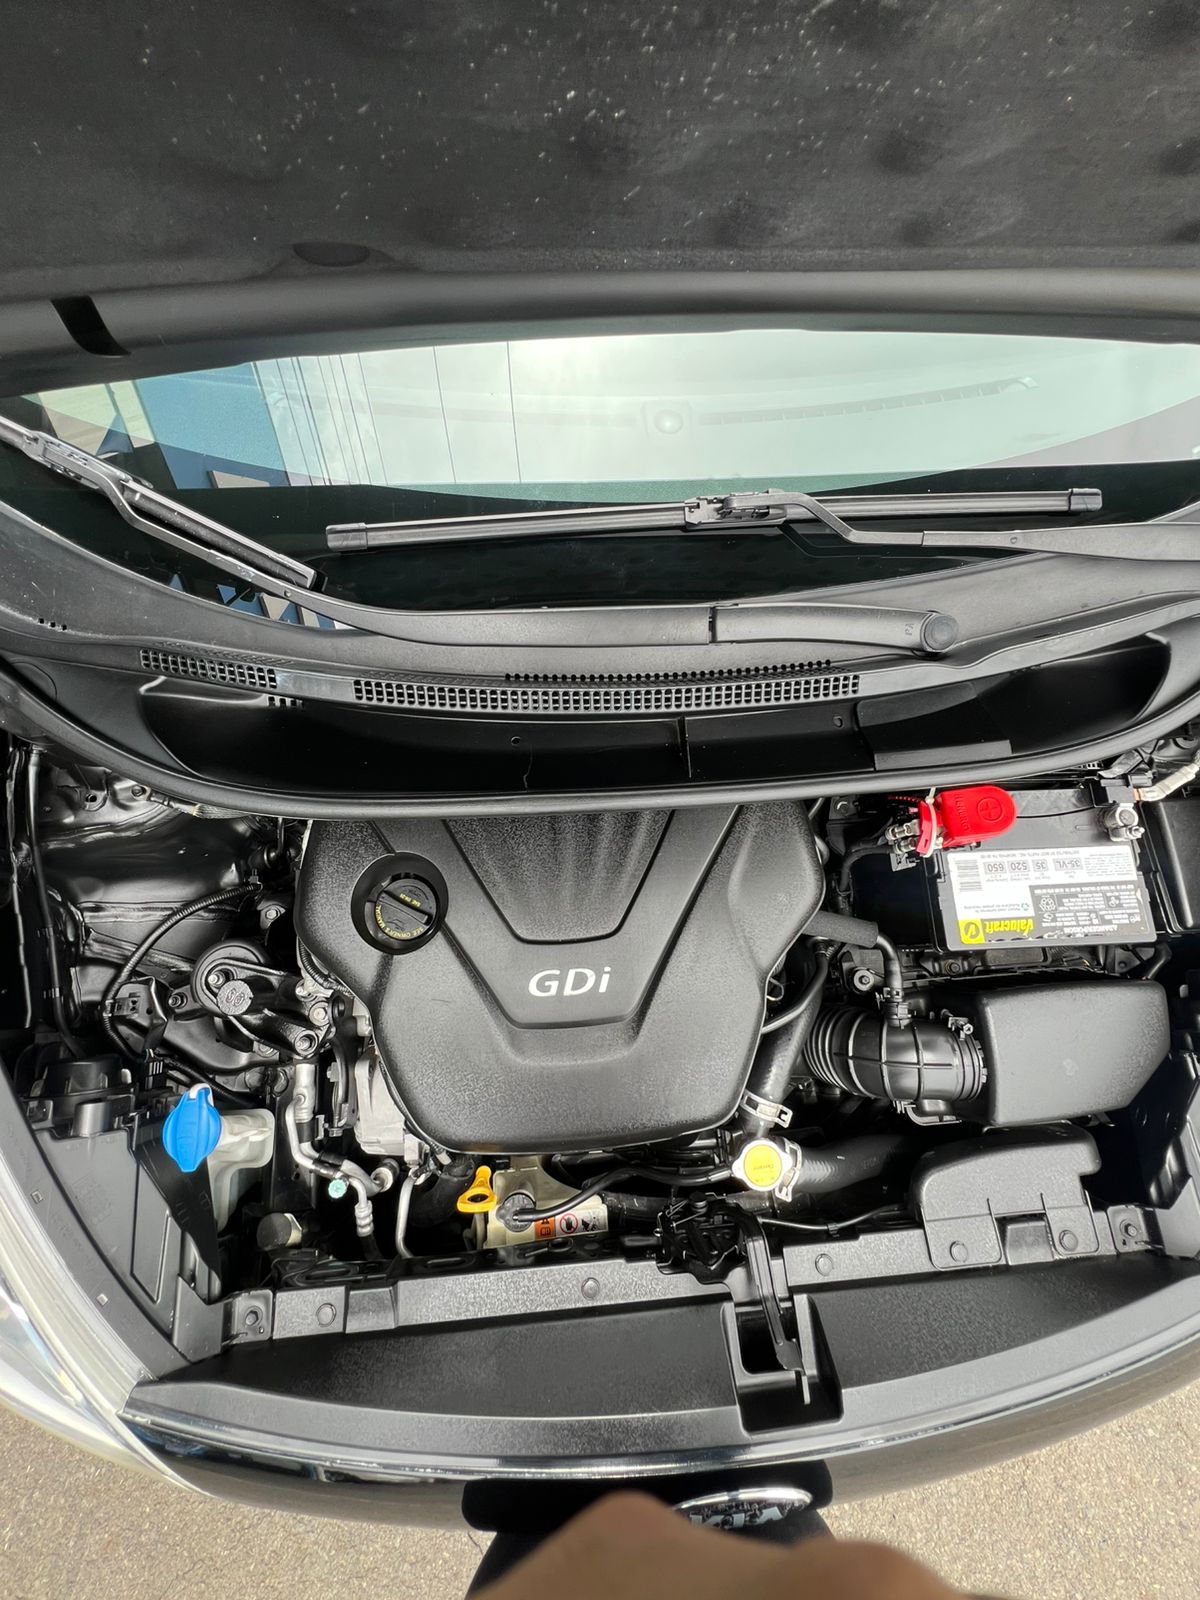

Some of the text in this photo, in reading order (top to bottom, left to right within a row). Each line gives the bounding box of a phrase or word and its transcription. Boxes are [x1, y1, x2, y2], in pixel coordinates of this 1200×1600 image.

[987, 863, 1004, 872] 650
[1010, 862, 1027, 871] 520
[1035, 861, 1046, 870] 35
[528, 966, 611, 997] GDi
